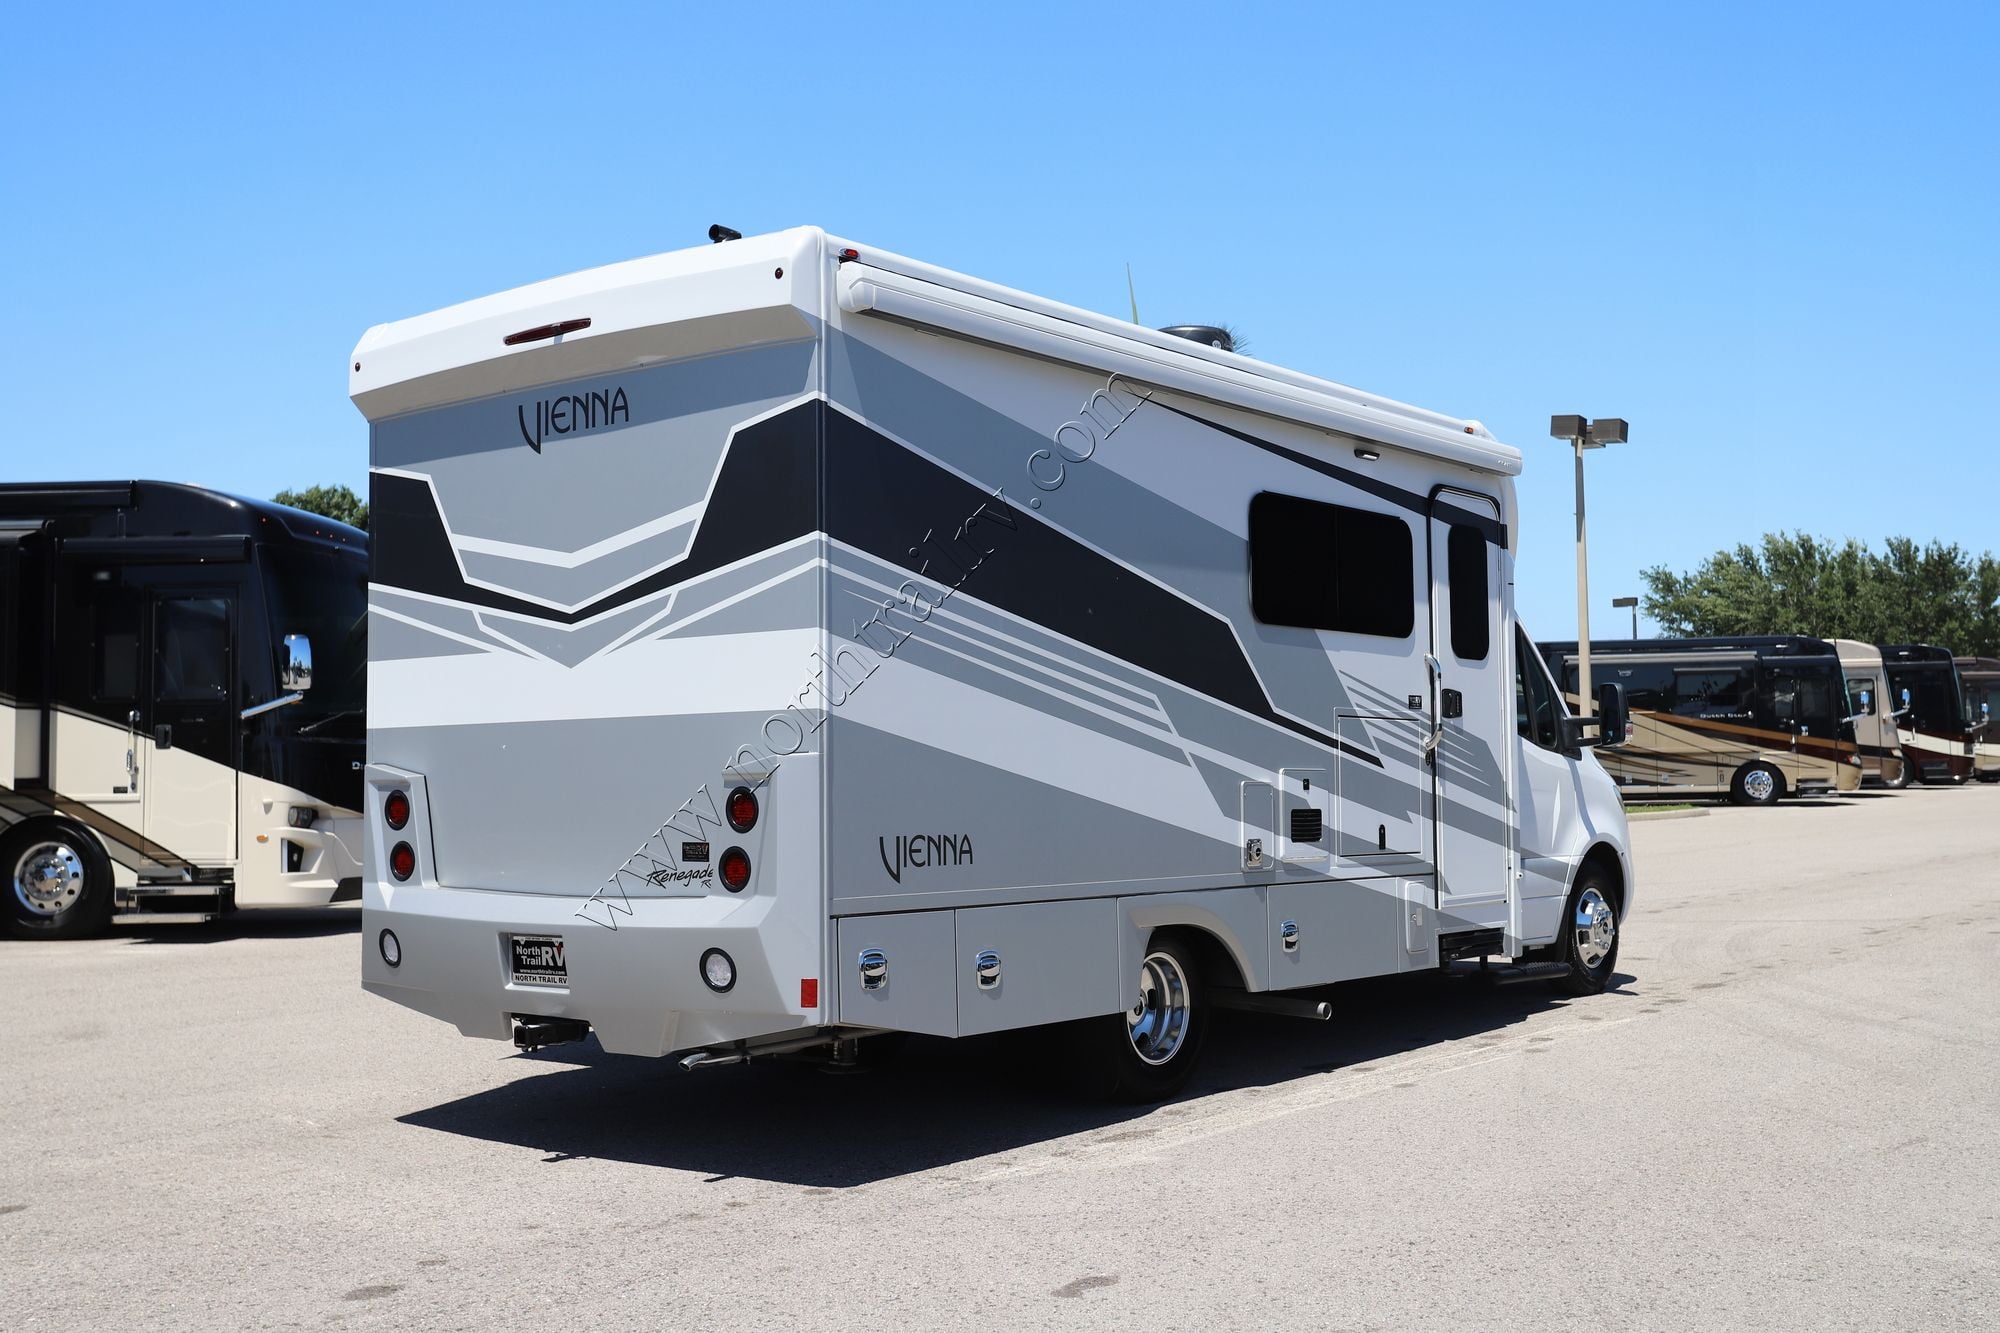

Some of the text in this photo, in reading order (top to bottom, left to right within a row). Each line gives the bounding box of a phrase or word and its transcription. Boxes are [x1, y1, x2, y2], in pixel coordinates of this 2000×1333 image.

[518, 386, 629, 455] VIENNA
[879, 833, 973, 884] VIENNA
[646, 863, 713, 889] Renegade
[516, 945, 540, 955] North
[521, 956, 540, 965] Trail
[541, 946, 565, 966] RV
